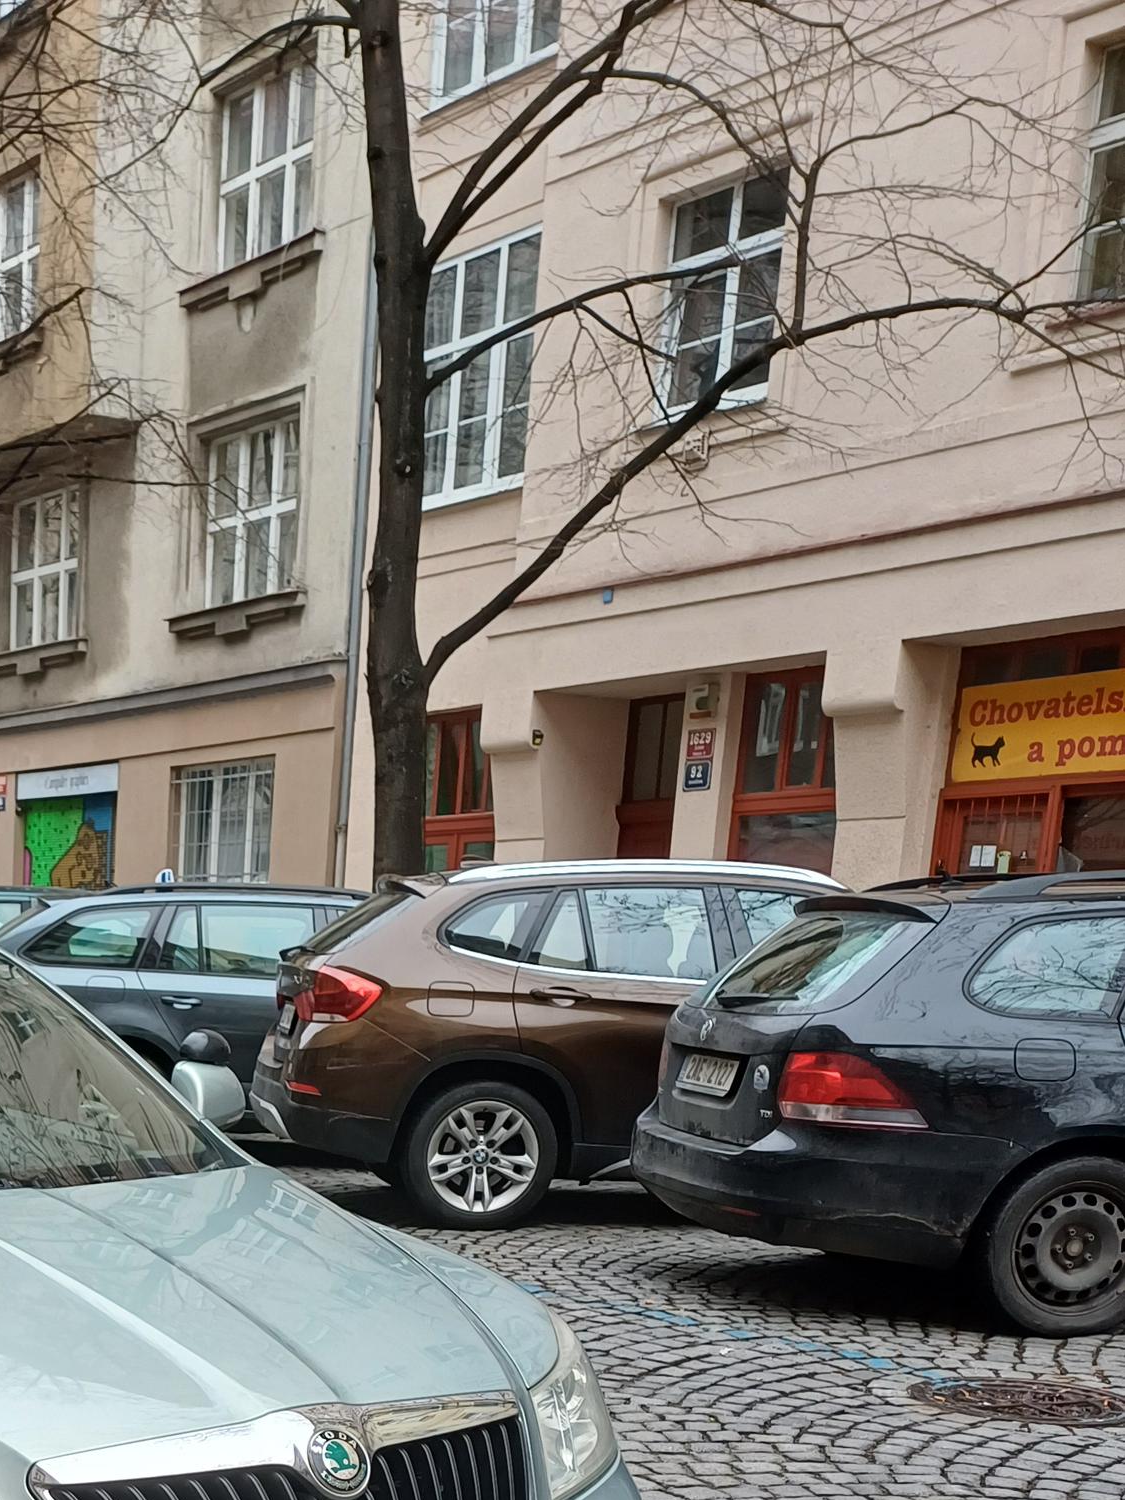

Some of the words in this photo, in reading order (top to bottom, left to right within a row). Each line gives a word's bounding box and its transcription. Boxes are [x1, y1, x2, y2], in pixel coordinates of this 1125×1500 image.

[969, 687, 1125, 727] Chovatels
[689, 731, 712, 746] 1629
[1027, 740, 1045, 763] a
[1055, 733, 1125, 767] pom
[690, 765, 703, 779] 92
